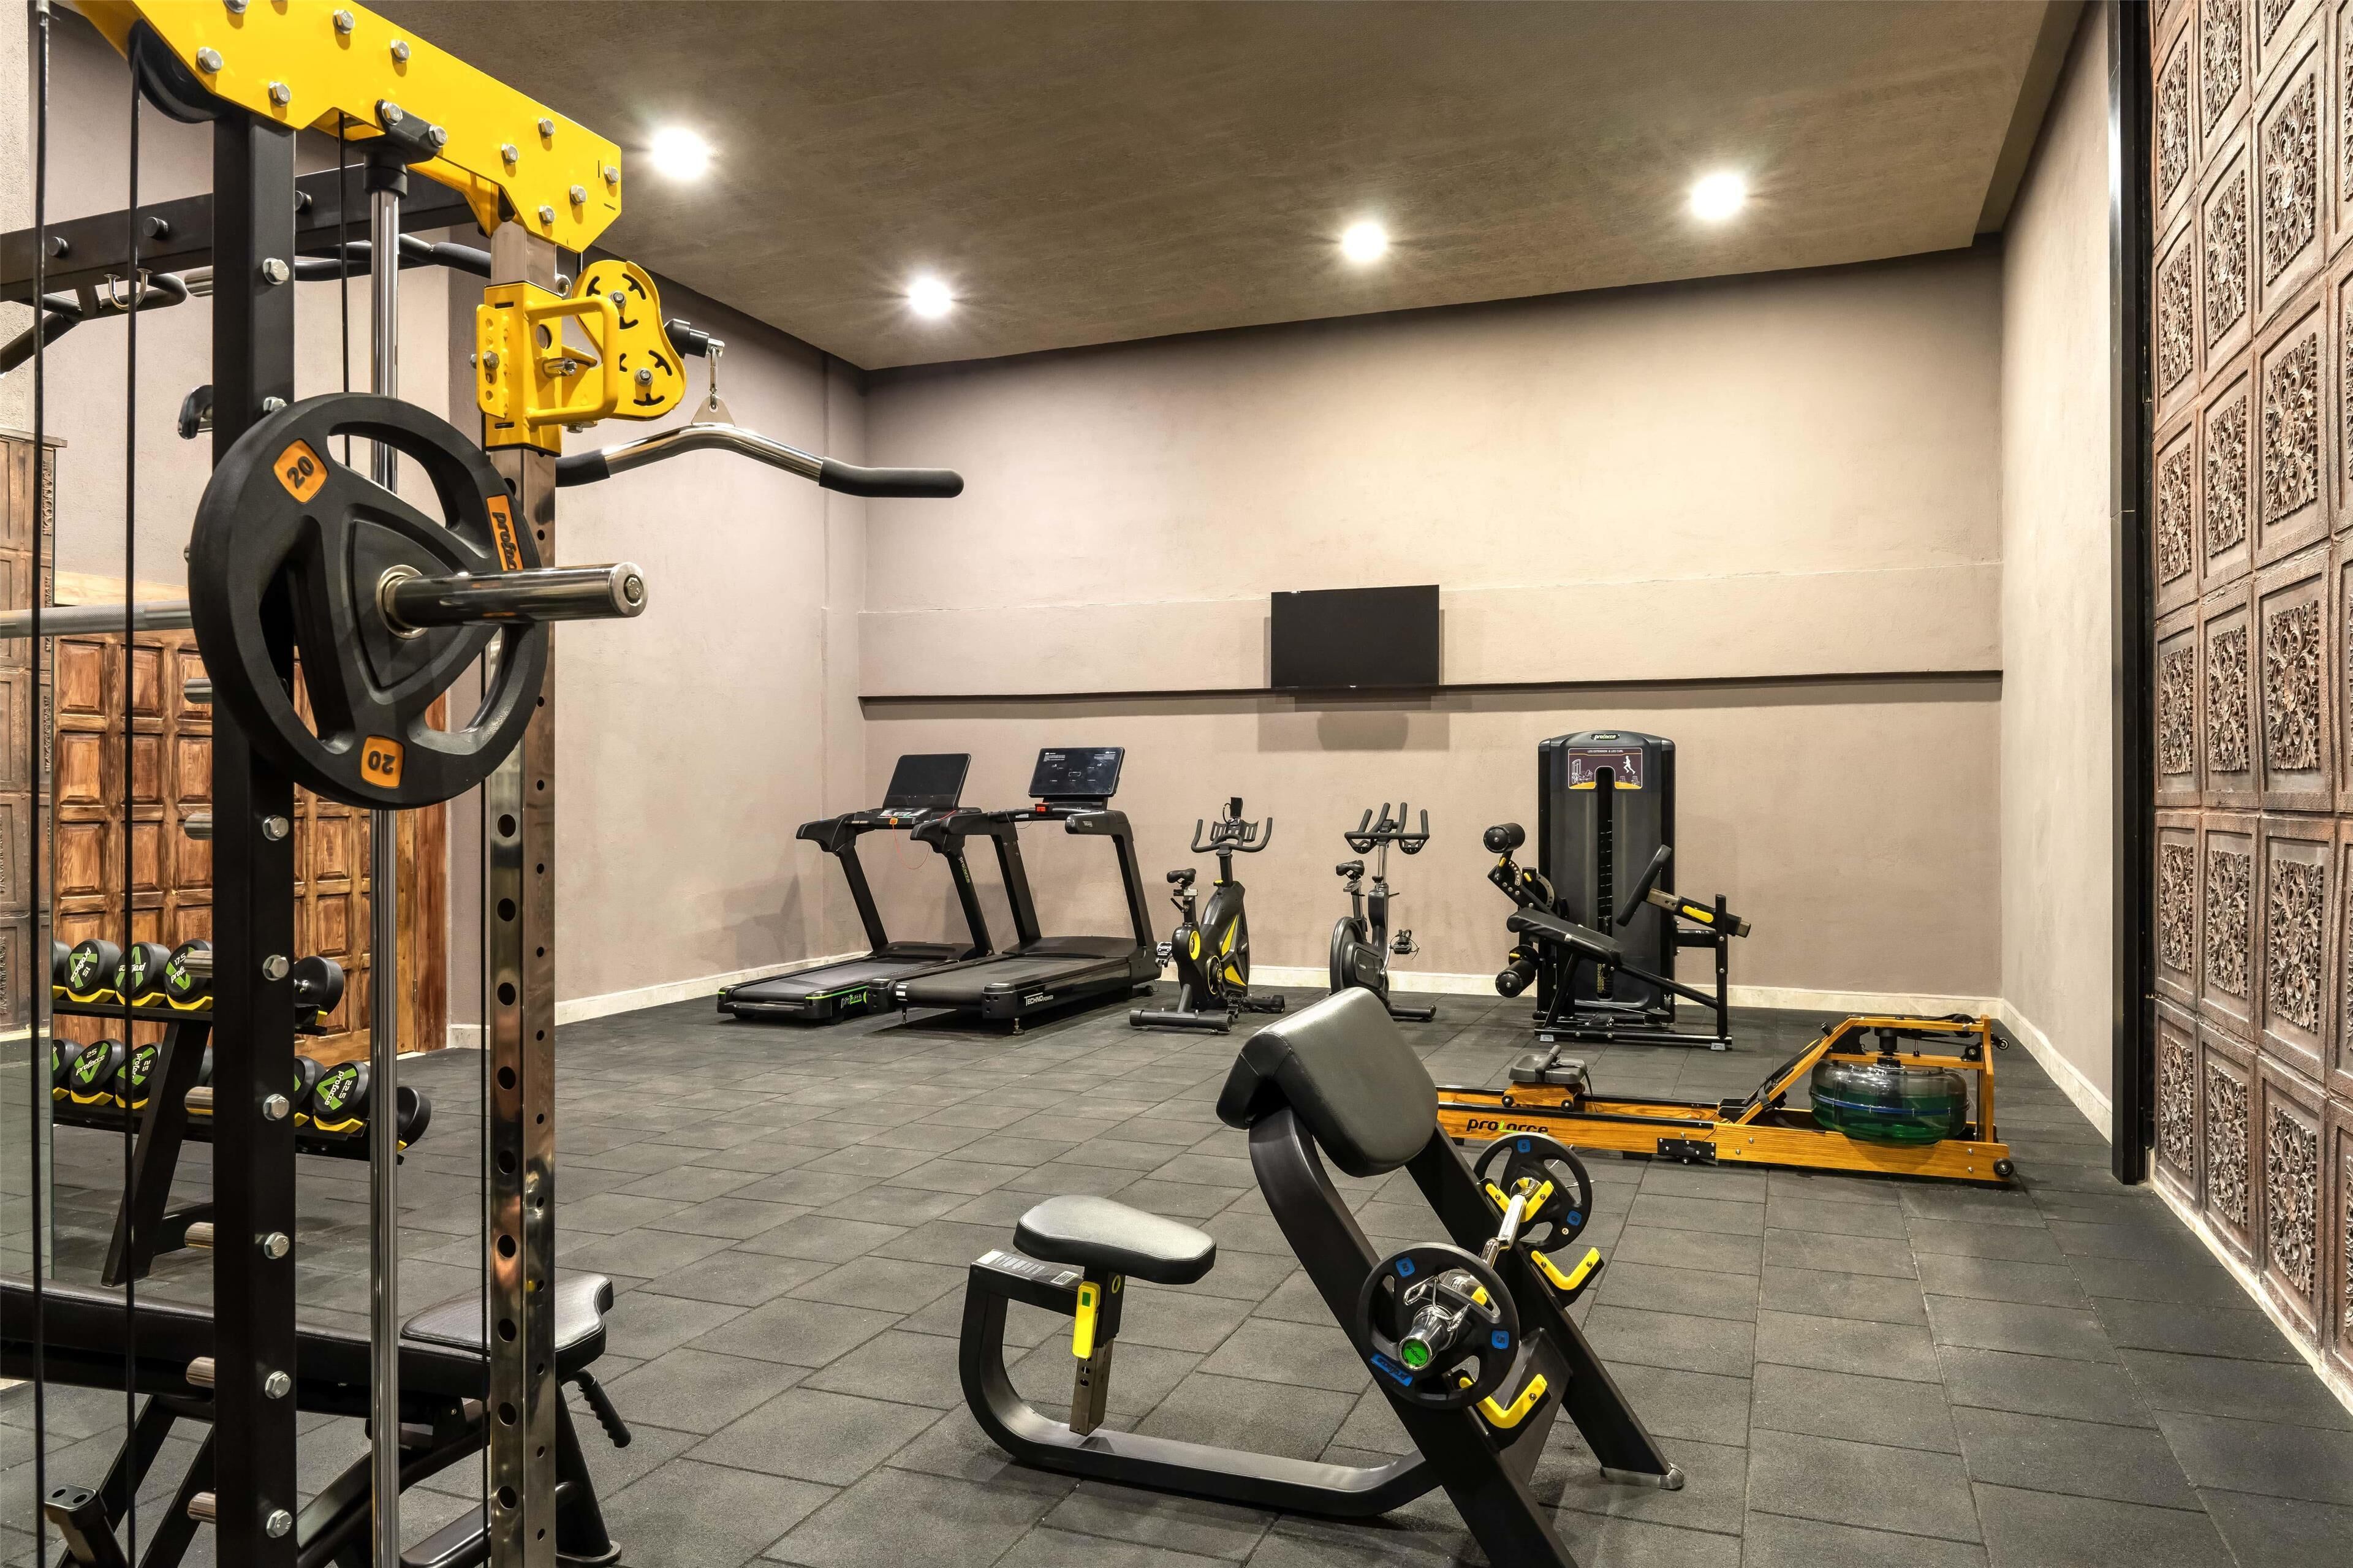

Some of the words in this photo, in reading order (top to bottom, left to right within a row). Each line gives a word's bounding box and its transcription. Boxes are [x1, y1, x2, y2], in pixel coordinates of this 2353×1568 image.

[287, 456, 314, 490] 20
[492, 512, 517, 570] profor
[368, 751, 396, 776] 20
[70, 947, 91, 982] proforce
[75, 1055, 105, 1076] proforce
[86, 1048, 97, 1059] 25
[142, 1059, 151, 1072] 25
[324, 1070, 345, 1105] proforce
[338, 1080, 352, 1099] 22.5
